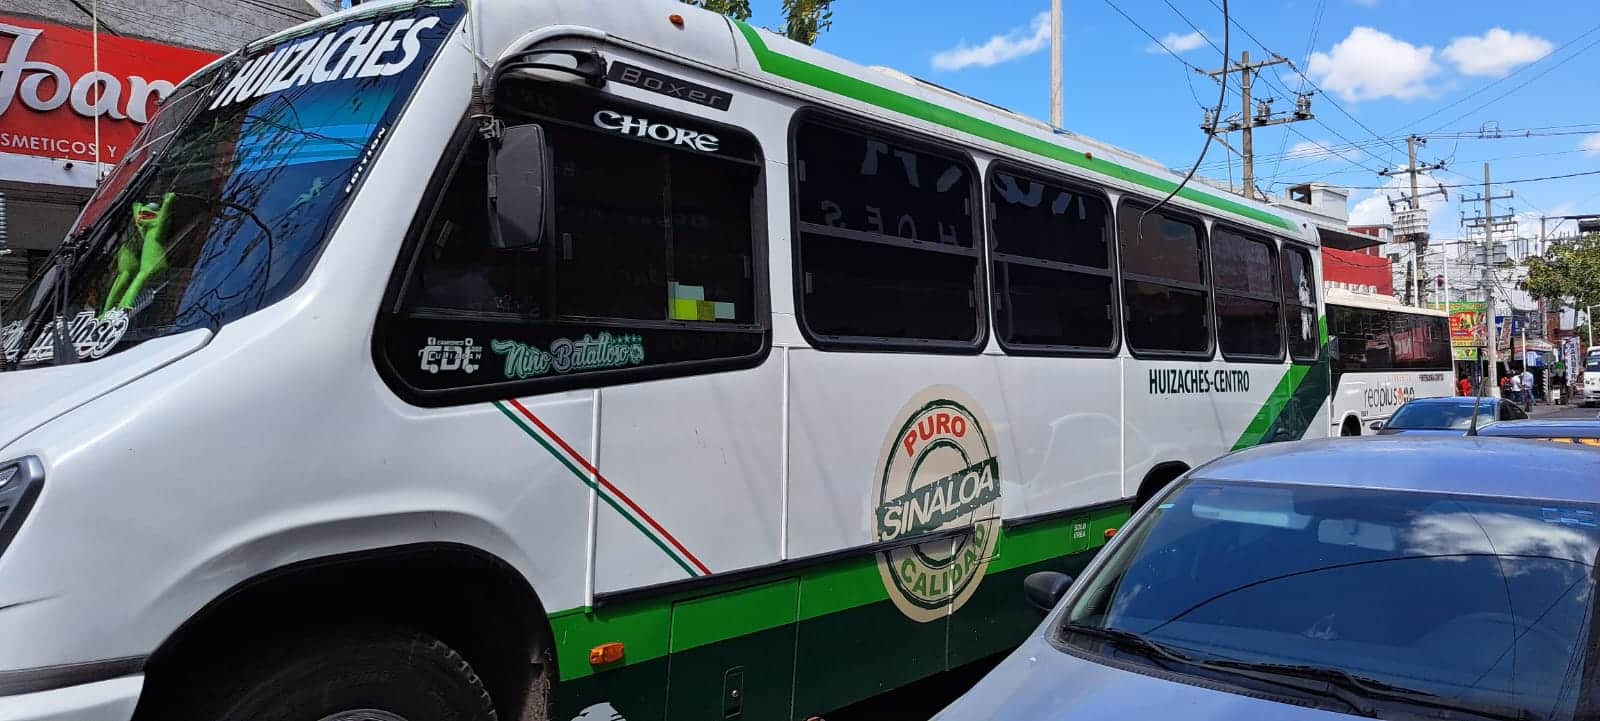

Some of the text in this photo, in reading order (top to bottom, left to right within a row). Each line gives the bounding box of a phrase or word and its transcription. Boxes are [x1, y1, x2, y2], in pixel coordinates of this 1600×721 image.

[206, 16, 440, 111] HUIZACHES
[619, 66, 722, 106] Boxer
[0, 133, 117, 158] SMETICOS Y
[593, 109, 720, 152] CHORE
[345, 127, 386, 193] EDITION
[1149, 368, 1250, 395] HUIZACHES-CENTRO
[903, 413, 967, 458] PURO
[881, 464, 994, 540] SINALOA
[900, 523, 986, 597] CALIDAD
